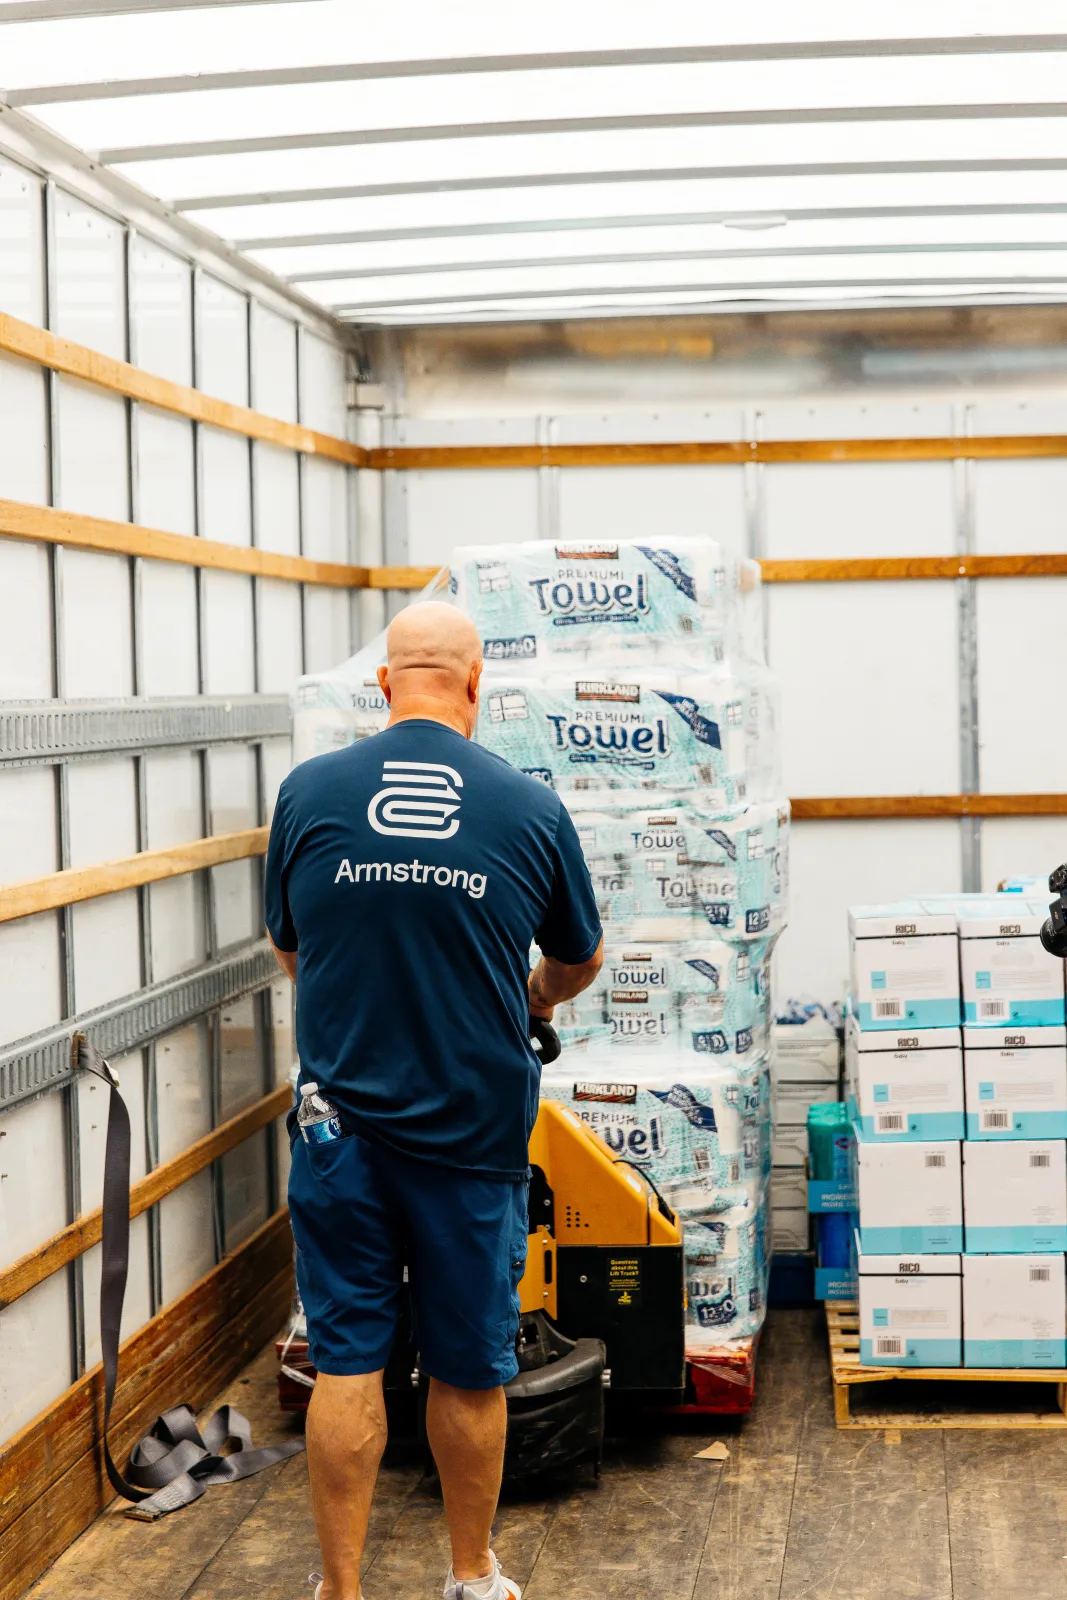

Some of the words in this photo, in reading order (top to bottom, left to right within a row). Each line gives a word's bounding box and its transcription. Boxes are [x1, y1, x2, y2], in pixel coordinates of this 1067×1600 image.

[528, 573, 647, 609] Towel
[577, 683, 639, 697] KIRKLAND
[575, 711, 641, 724] PREMIUM
[545, 713, 667, 754] Towel
[334, 858, 488, 899] Armstrong
[895, 924, 917, 934] RICO
[999, 924, 1021, 934] RICO
[610, 967, 666, 985] Towel
[897, 1037, 919, 1047] RICO
[1004, 1035, 1026, 1045] RICO
[576, 1083, 636, 1096] KIRKLAND
[899, 1262, 920, 1272] RICO
